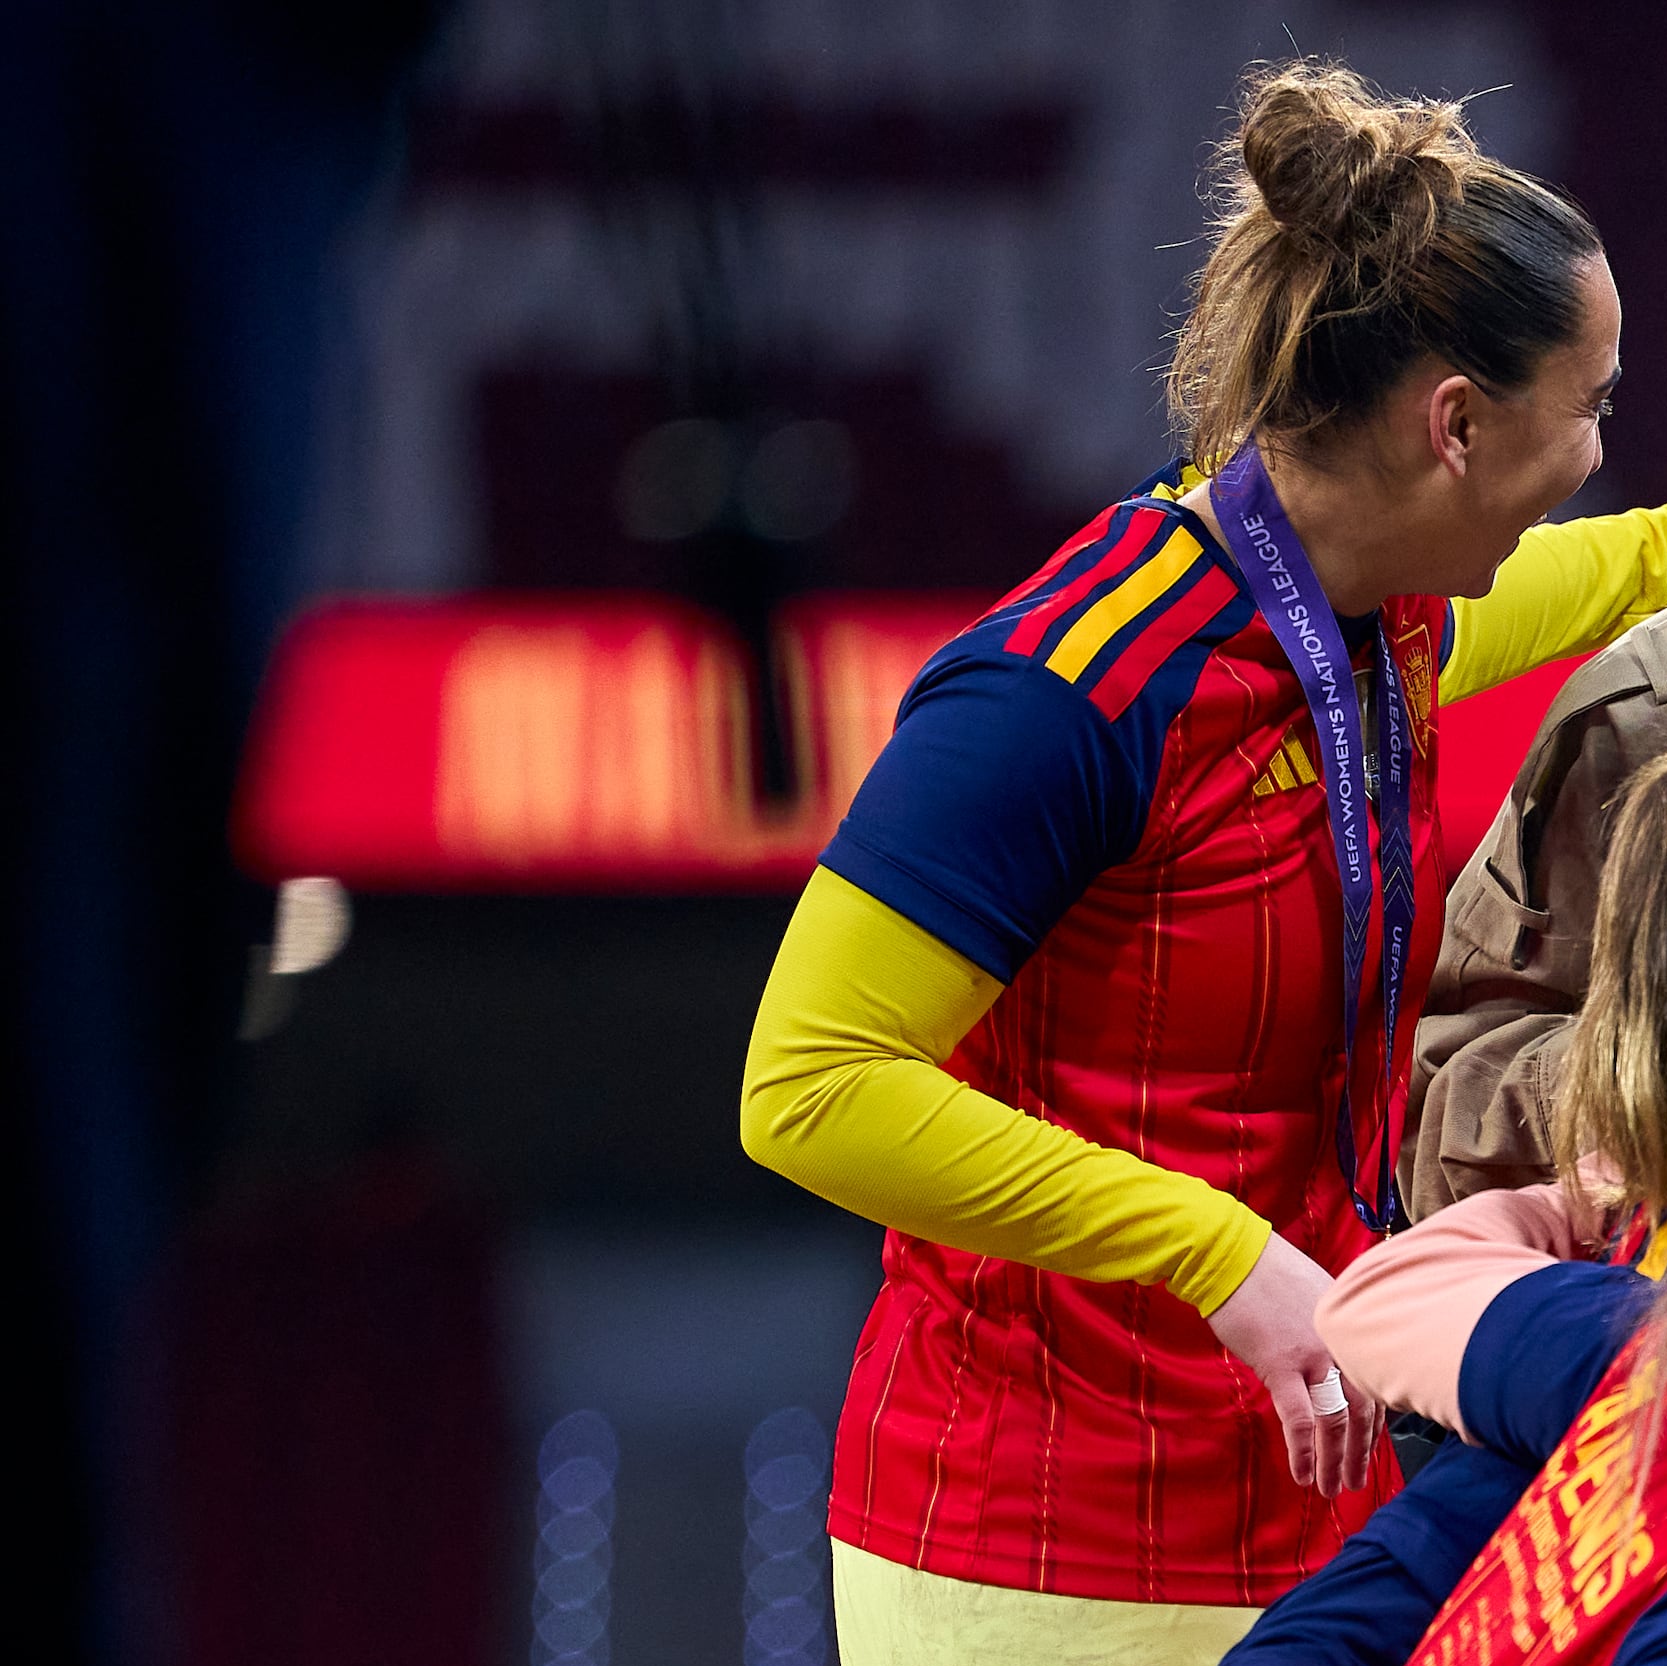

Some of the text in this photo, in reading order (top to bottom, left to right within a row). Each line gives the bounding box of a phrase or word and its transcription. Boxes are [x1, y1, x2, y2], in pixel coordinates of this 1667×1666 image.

[1242, 513, 1362, 883] UEFA WOMEN'S NATIONS LEAGUE
[1387, 691, 1402, 785] LEAGUE
[1390, 925, 1403, 983] UEFA
